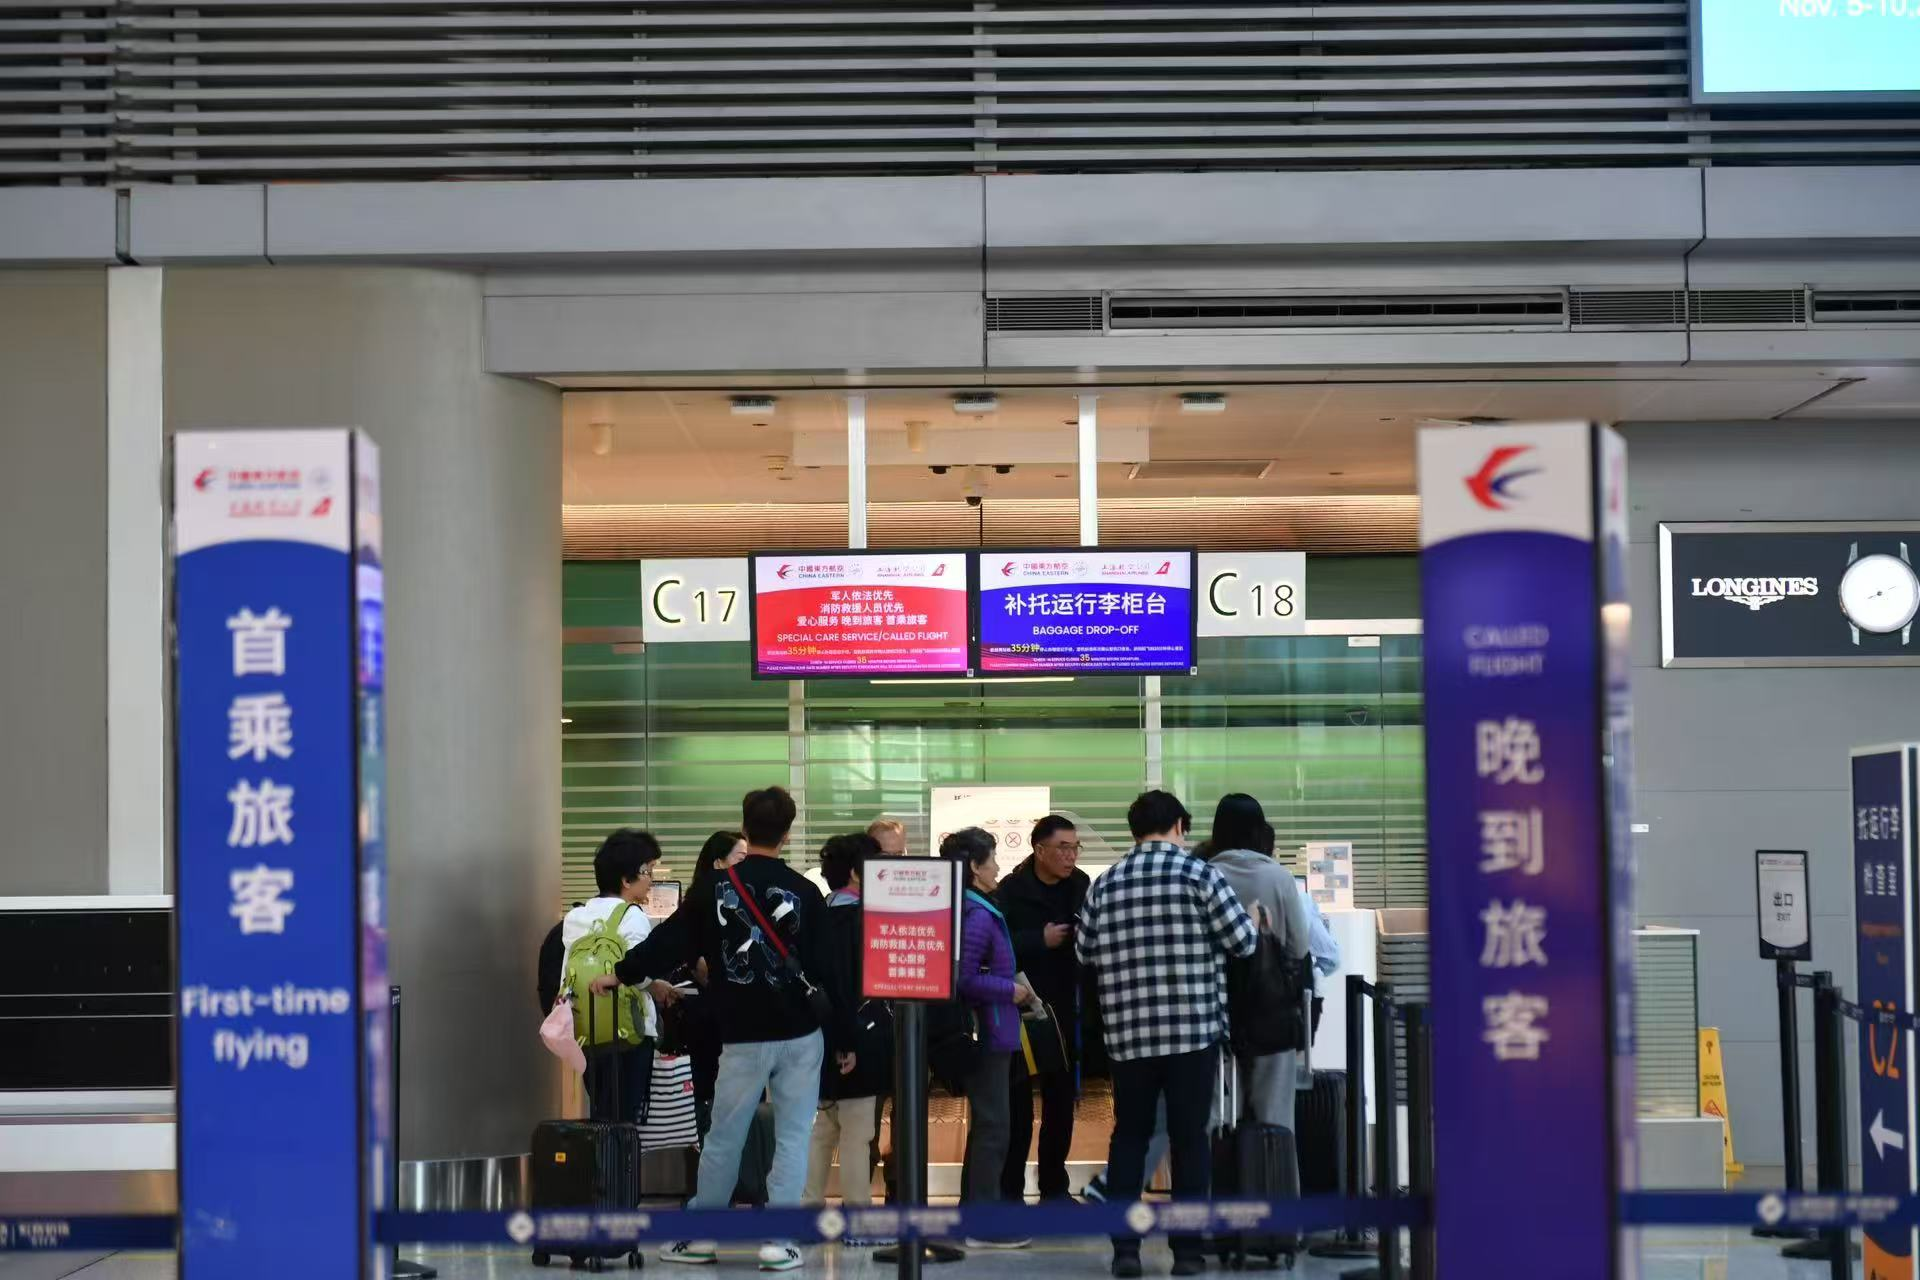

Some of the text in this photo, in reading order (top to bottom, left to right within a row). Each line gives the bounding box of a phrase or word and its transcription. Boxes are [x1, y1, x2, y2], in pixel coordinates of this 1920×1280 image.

[1846, 0, 1920, 19] 5-10,
[1691, 577, 1819, 597] LONGINES
[831, 590, 894, 601] 军人依法优先
[820, 603, 905, 614] 消防救援人员优先
[1004, 592, 1167, 617] 补托运行李柜台
[796, 614, 929, 627] 爱心服务 晚到旅客 首乘旅客
[777, 631, 948, 642] SPECIAL CARE SERVICE/CALLED FLIGHT
[1033, 625, 1140, 636] BAGGAGE DROP-OFF
[1080, 653, 1090, 662] 35
[226, 606, 295, 936] 首乘旅客
[1475, 716, 1550, 1061] 晚到旅客
[1773, 892, 1793, 907] 出口
[879, 925, 936, 937] 军人依法优先
[870, 938, 945, 951] 消防救援人员优先
[182, 982, 350, 1018] First-time
[212, 1027, 309, 1070] flying
